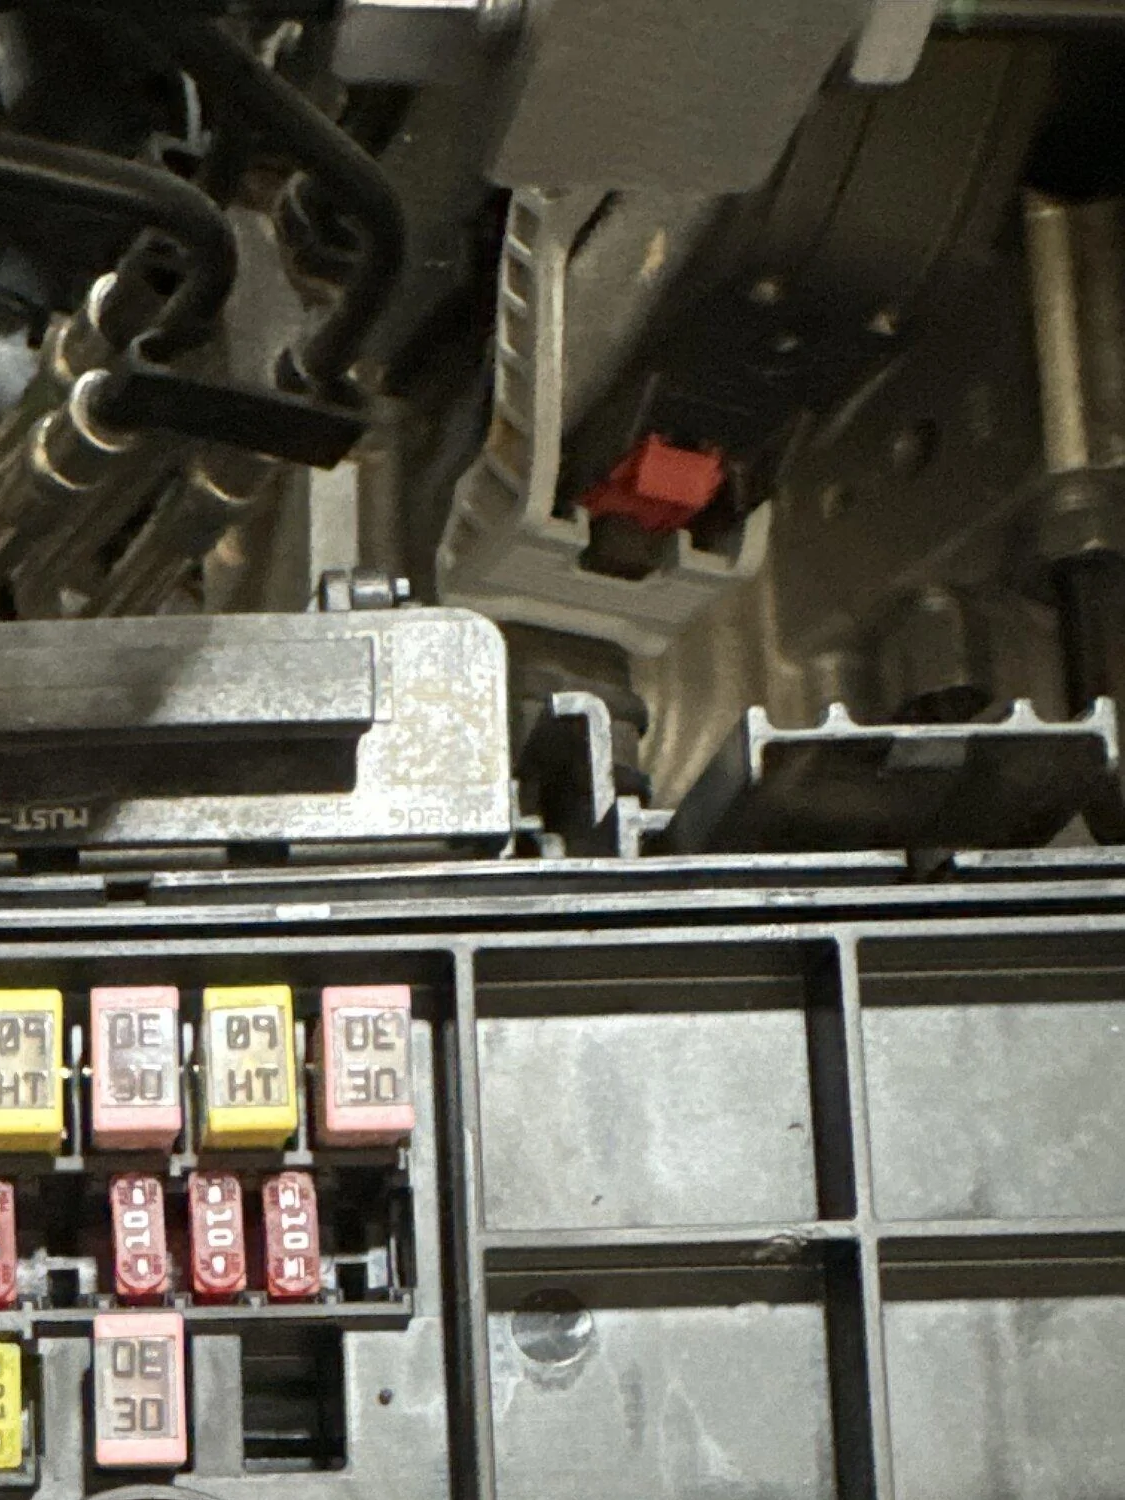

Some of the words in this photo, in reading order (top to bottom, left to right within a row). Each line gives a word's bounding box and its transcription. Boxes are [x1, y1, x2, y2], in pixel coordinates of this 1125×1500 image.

[111, 1068, 162, 1102] 30
[229, 1067, 278, 1102] HT
[350, 1068, 396, 1102] 30
[123, 1210, 150, 1248] 10
[206, 1209, 234, 1247] 10
[281, 1212, 309, 1249] 10
[114, 1397, 165, 1432] 30
